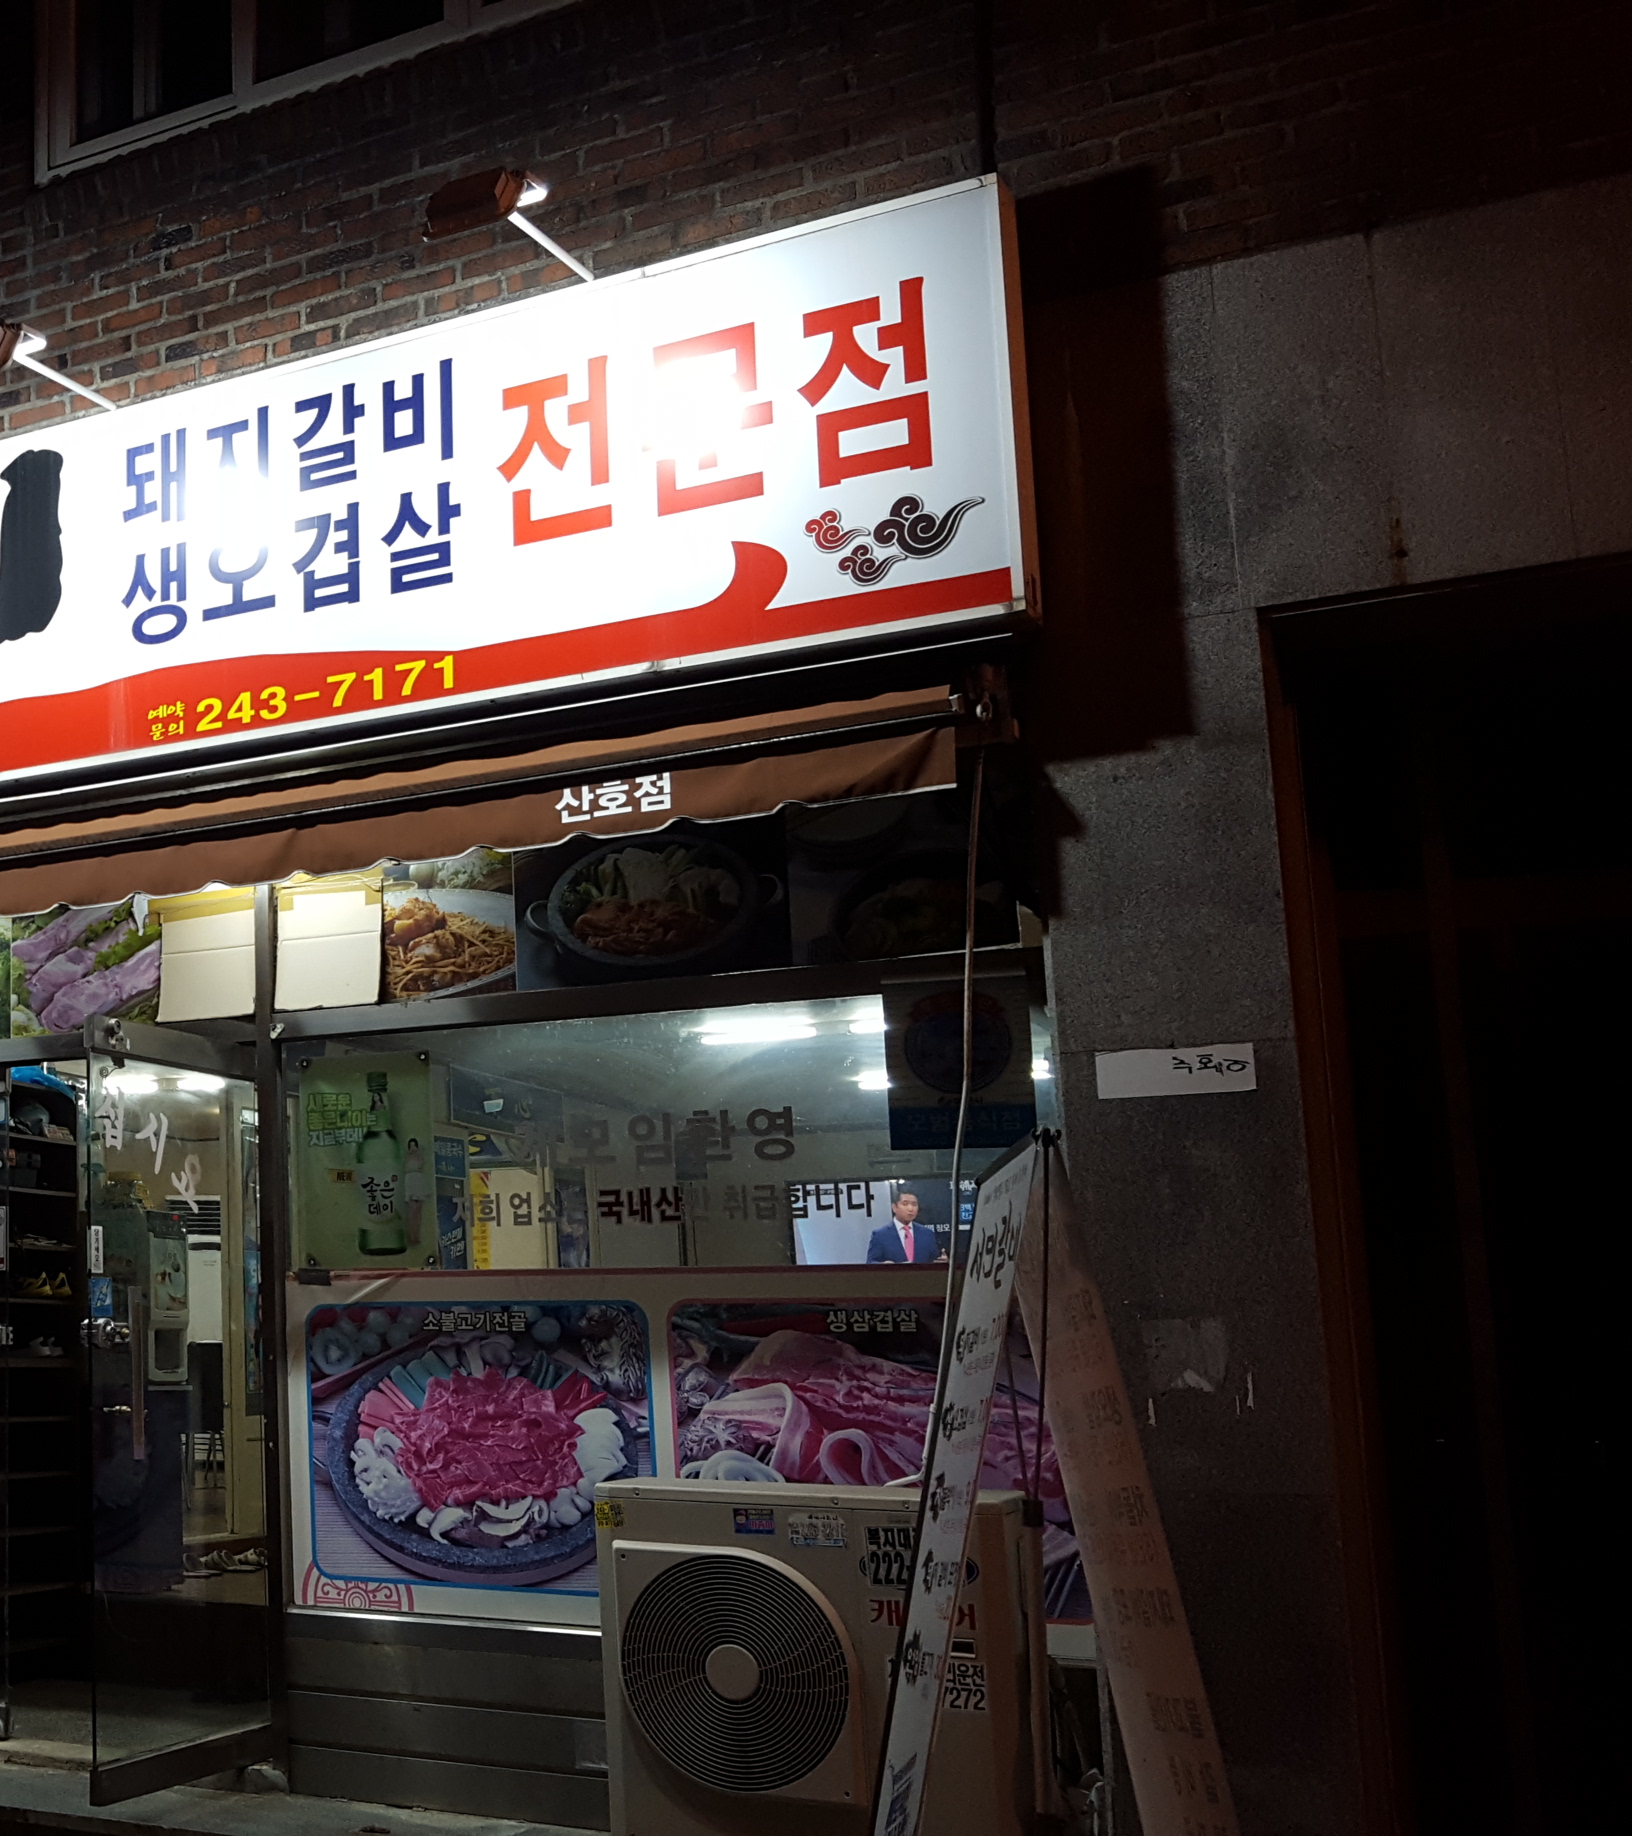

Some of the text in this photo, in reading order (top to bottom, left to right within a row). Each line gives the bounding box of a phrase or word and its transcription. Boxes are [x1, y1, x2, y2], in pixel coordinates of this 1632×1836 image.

[498, 276, 934, 547] 전문점
[123, 358, 453, 526] 돼지갈비
[121, 481, 461, 645] 생오겹살
[147, 655, 456, 732] 예약 243-7171
[149, 719, 185, 741] 문의
[555, 771, 672, 825] 산호점
[423, 1310, 527, 1333] 소불고기전골
[826, 1308, 918, 1333] 생삼겹살
[867, 1527, 916, 1550] 복지대
